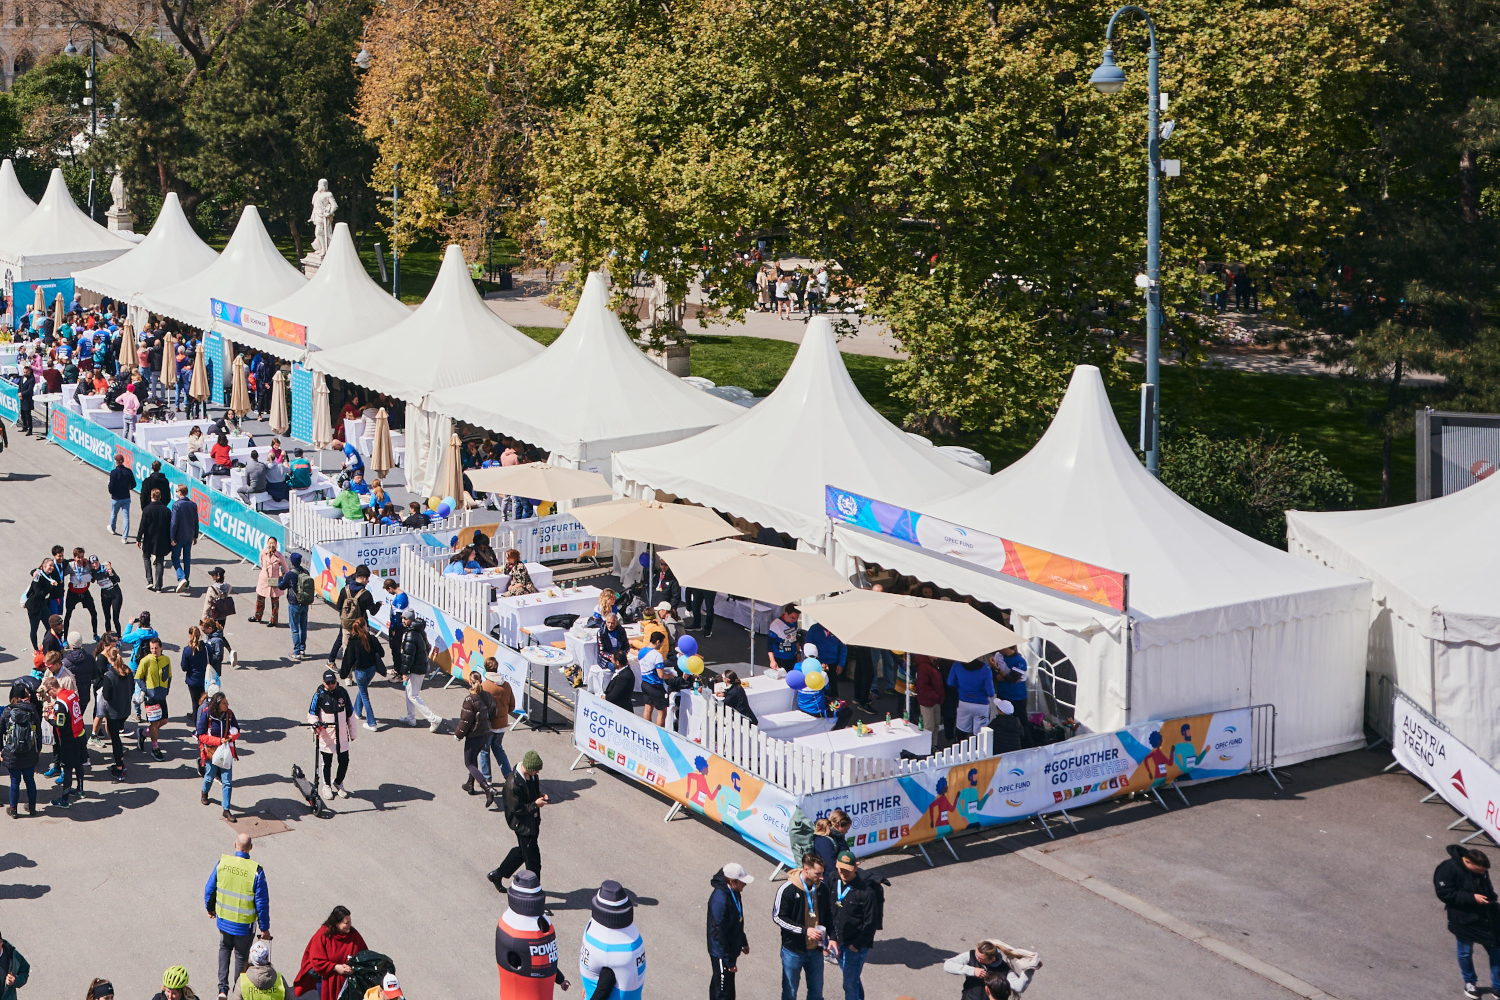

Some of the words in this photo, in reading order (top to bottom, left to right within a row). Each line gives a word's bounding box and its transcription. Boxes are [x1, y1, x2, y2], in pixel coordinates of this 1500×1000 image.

[250, 318, 266, 327] SCHENKER
[69, 425, 113, 462] SCHENKER
[213, 508, 281, 552] SCHENK
[532, 522, 586, 536] #GOFURTHE
[944, 535, 959, 546] OPEC
[959, 540, 974, 549] FUND
[583, 707, 660, 754] #GOFURTHER
[1403, 715, 1446, 760] AUSTRIA
[1214, 741, 1228, 750] OPEC
[1228, 737, 1243, 746] FUND
[1403, 730, 1435, 768] TREND
[1044, 748, 1119, 774] #GOFURTHER
[998, 783, 1014, 793] OPEC
[1015, 780, 1031, 790] FUND
[815, 795, 901, 820] #GFURTHER
[762, 813, 779, 828] OPEC
[780, 823, 789, 833] FU
[222, 864, 249, 878] PRESSE
[529, 940, 558, 956] POWE
[548, 950, 558, 964] AD
